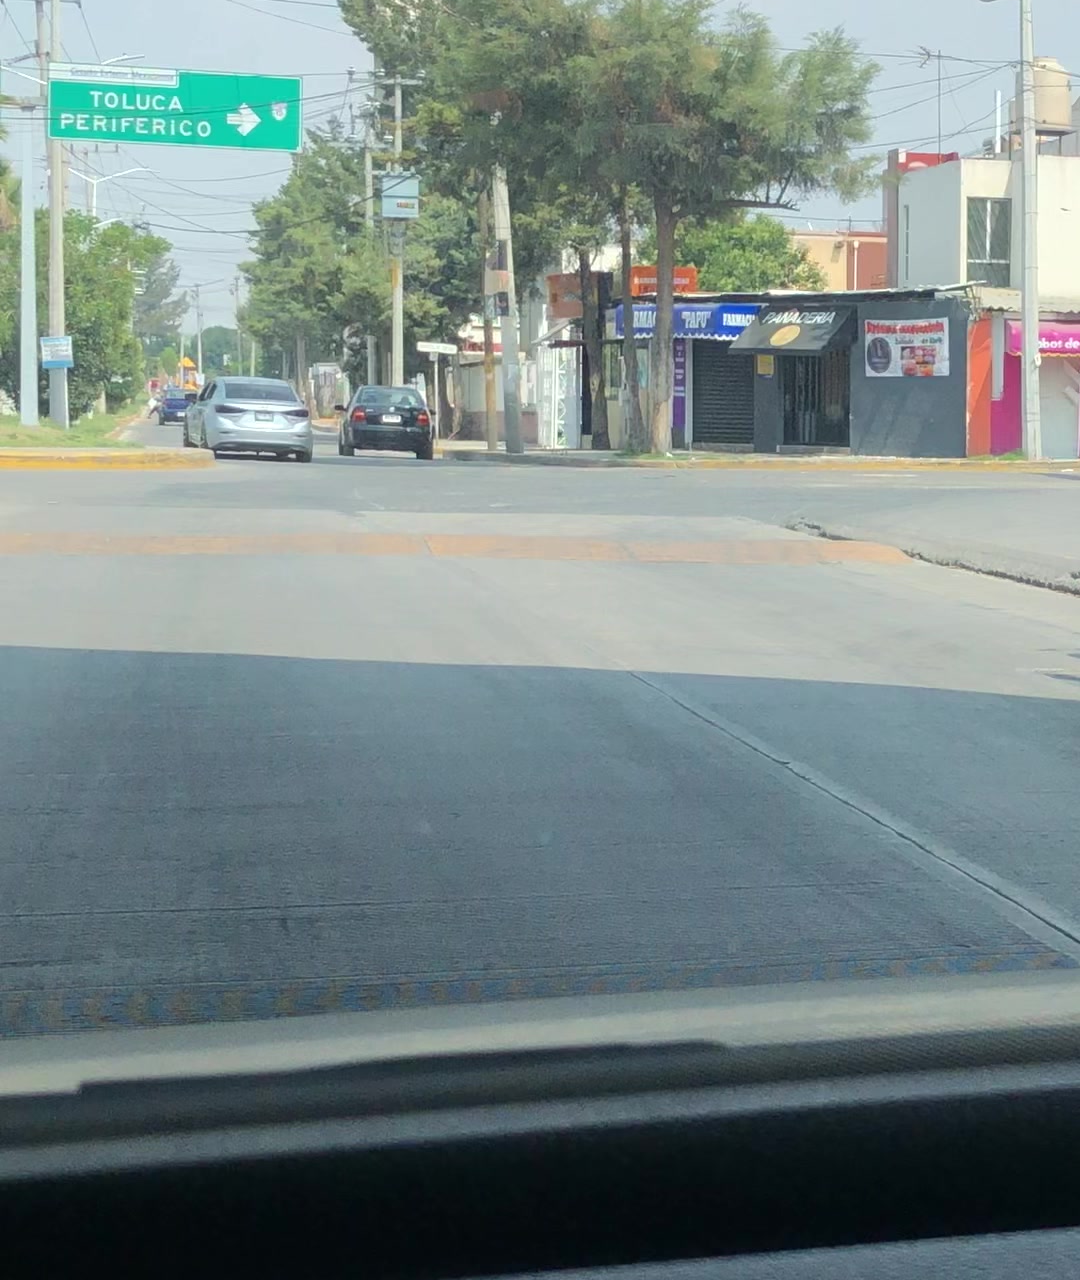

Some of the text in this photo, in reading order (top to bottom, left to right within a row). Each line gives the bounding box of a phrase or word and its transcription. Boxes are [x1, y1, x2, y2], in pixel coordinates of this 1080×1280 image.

[89, 90, 184, 113] TOLUCA
[60, 113, 212, 138] PERIFERICO
[762, 311, 836, 324] PANADERIA
[1064, 337, 1080, 350] de
